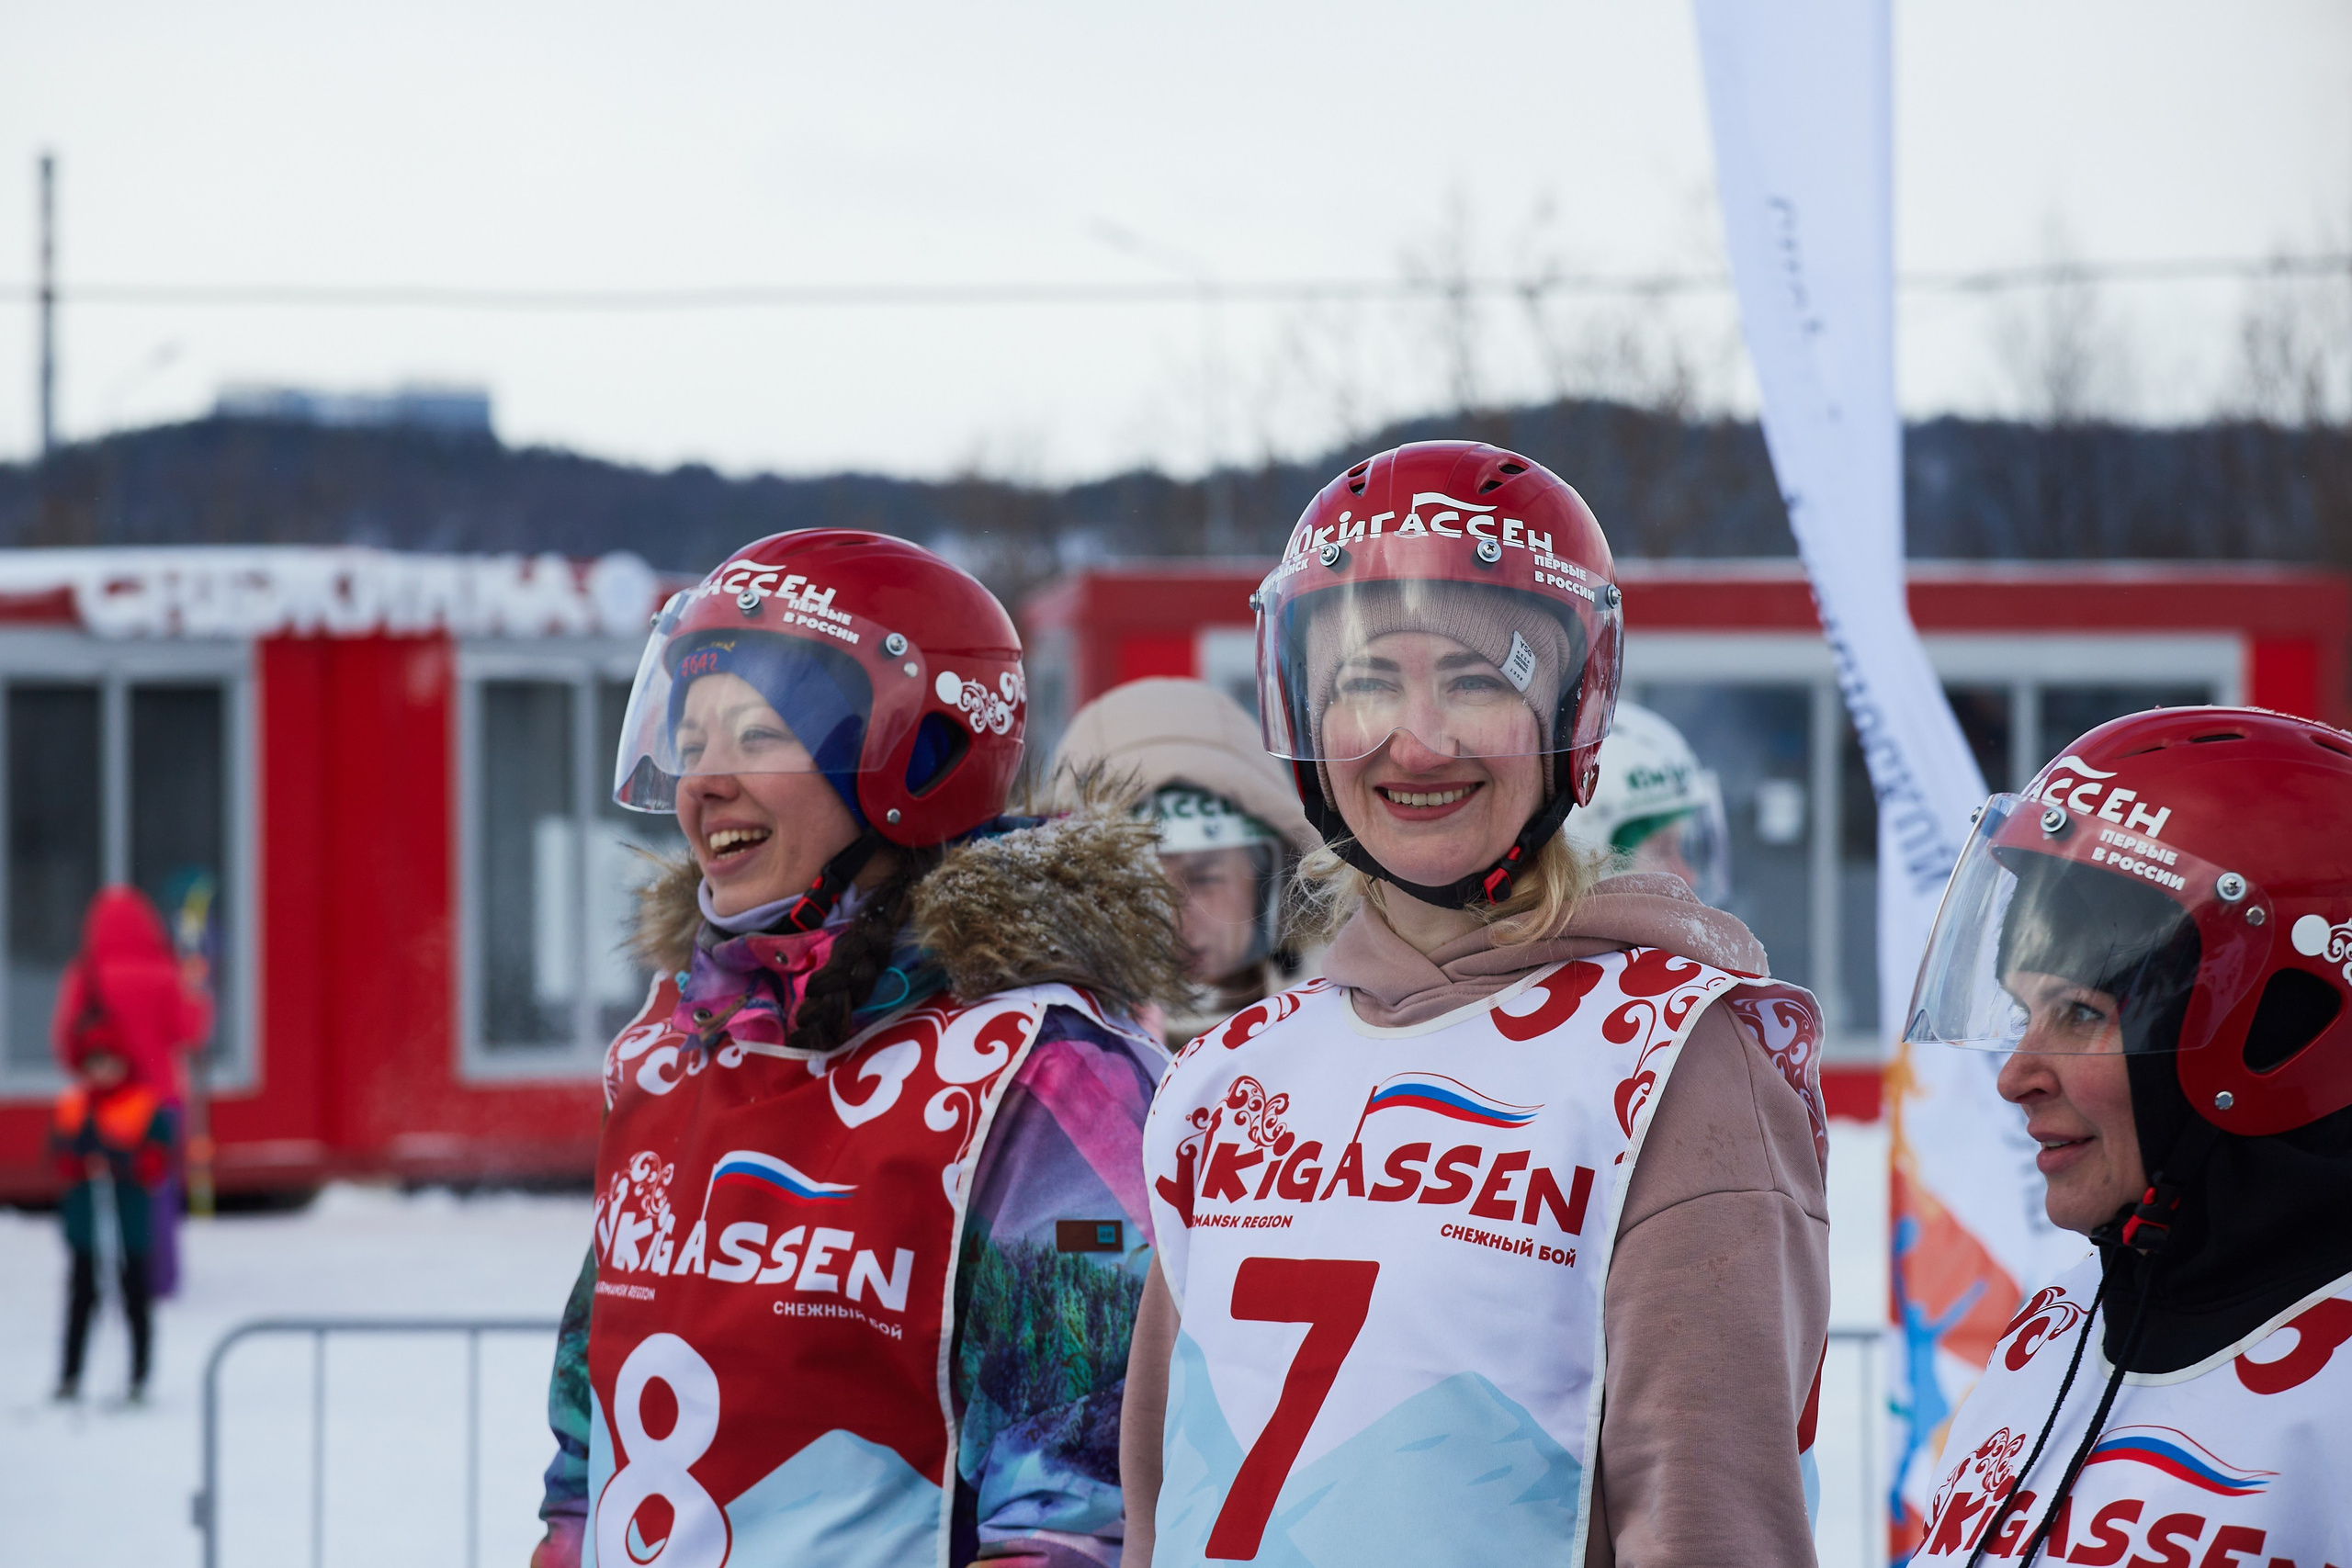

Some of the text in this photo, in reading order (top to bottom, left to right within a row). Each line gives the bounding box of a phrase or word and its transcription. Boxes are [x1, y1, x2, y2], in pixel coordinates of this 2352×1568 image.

[1534, 554, 1587, 581] ПЕРВЫЕ
[1534, 570, 1595, 603] В РОССИИ
[783, 612, 860, 644] В РОССИИ
[787, 598, 853, 626] ПЕРВЫЕ
[2098, 829, 2178, 866] ПЕРВЫЕ
[2091, 846, 2187, 891] В РОССИИ
[1240, 1213, 1294, 1229] REGION
[1440, 1224, 1577, 1269] СНЕЖНЫЙ БОЙ
[1205, 1257, 1380, 1561] 7
[595, 1333, 732, 1568] 8
